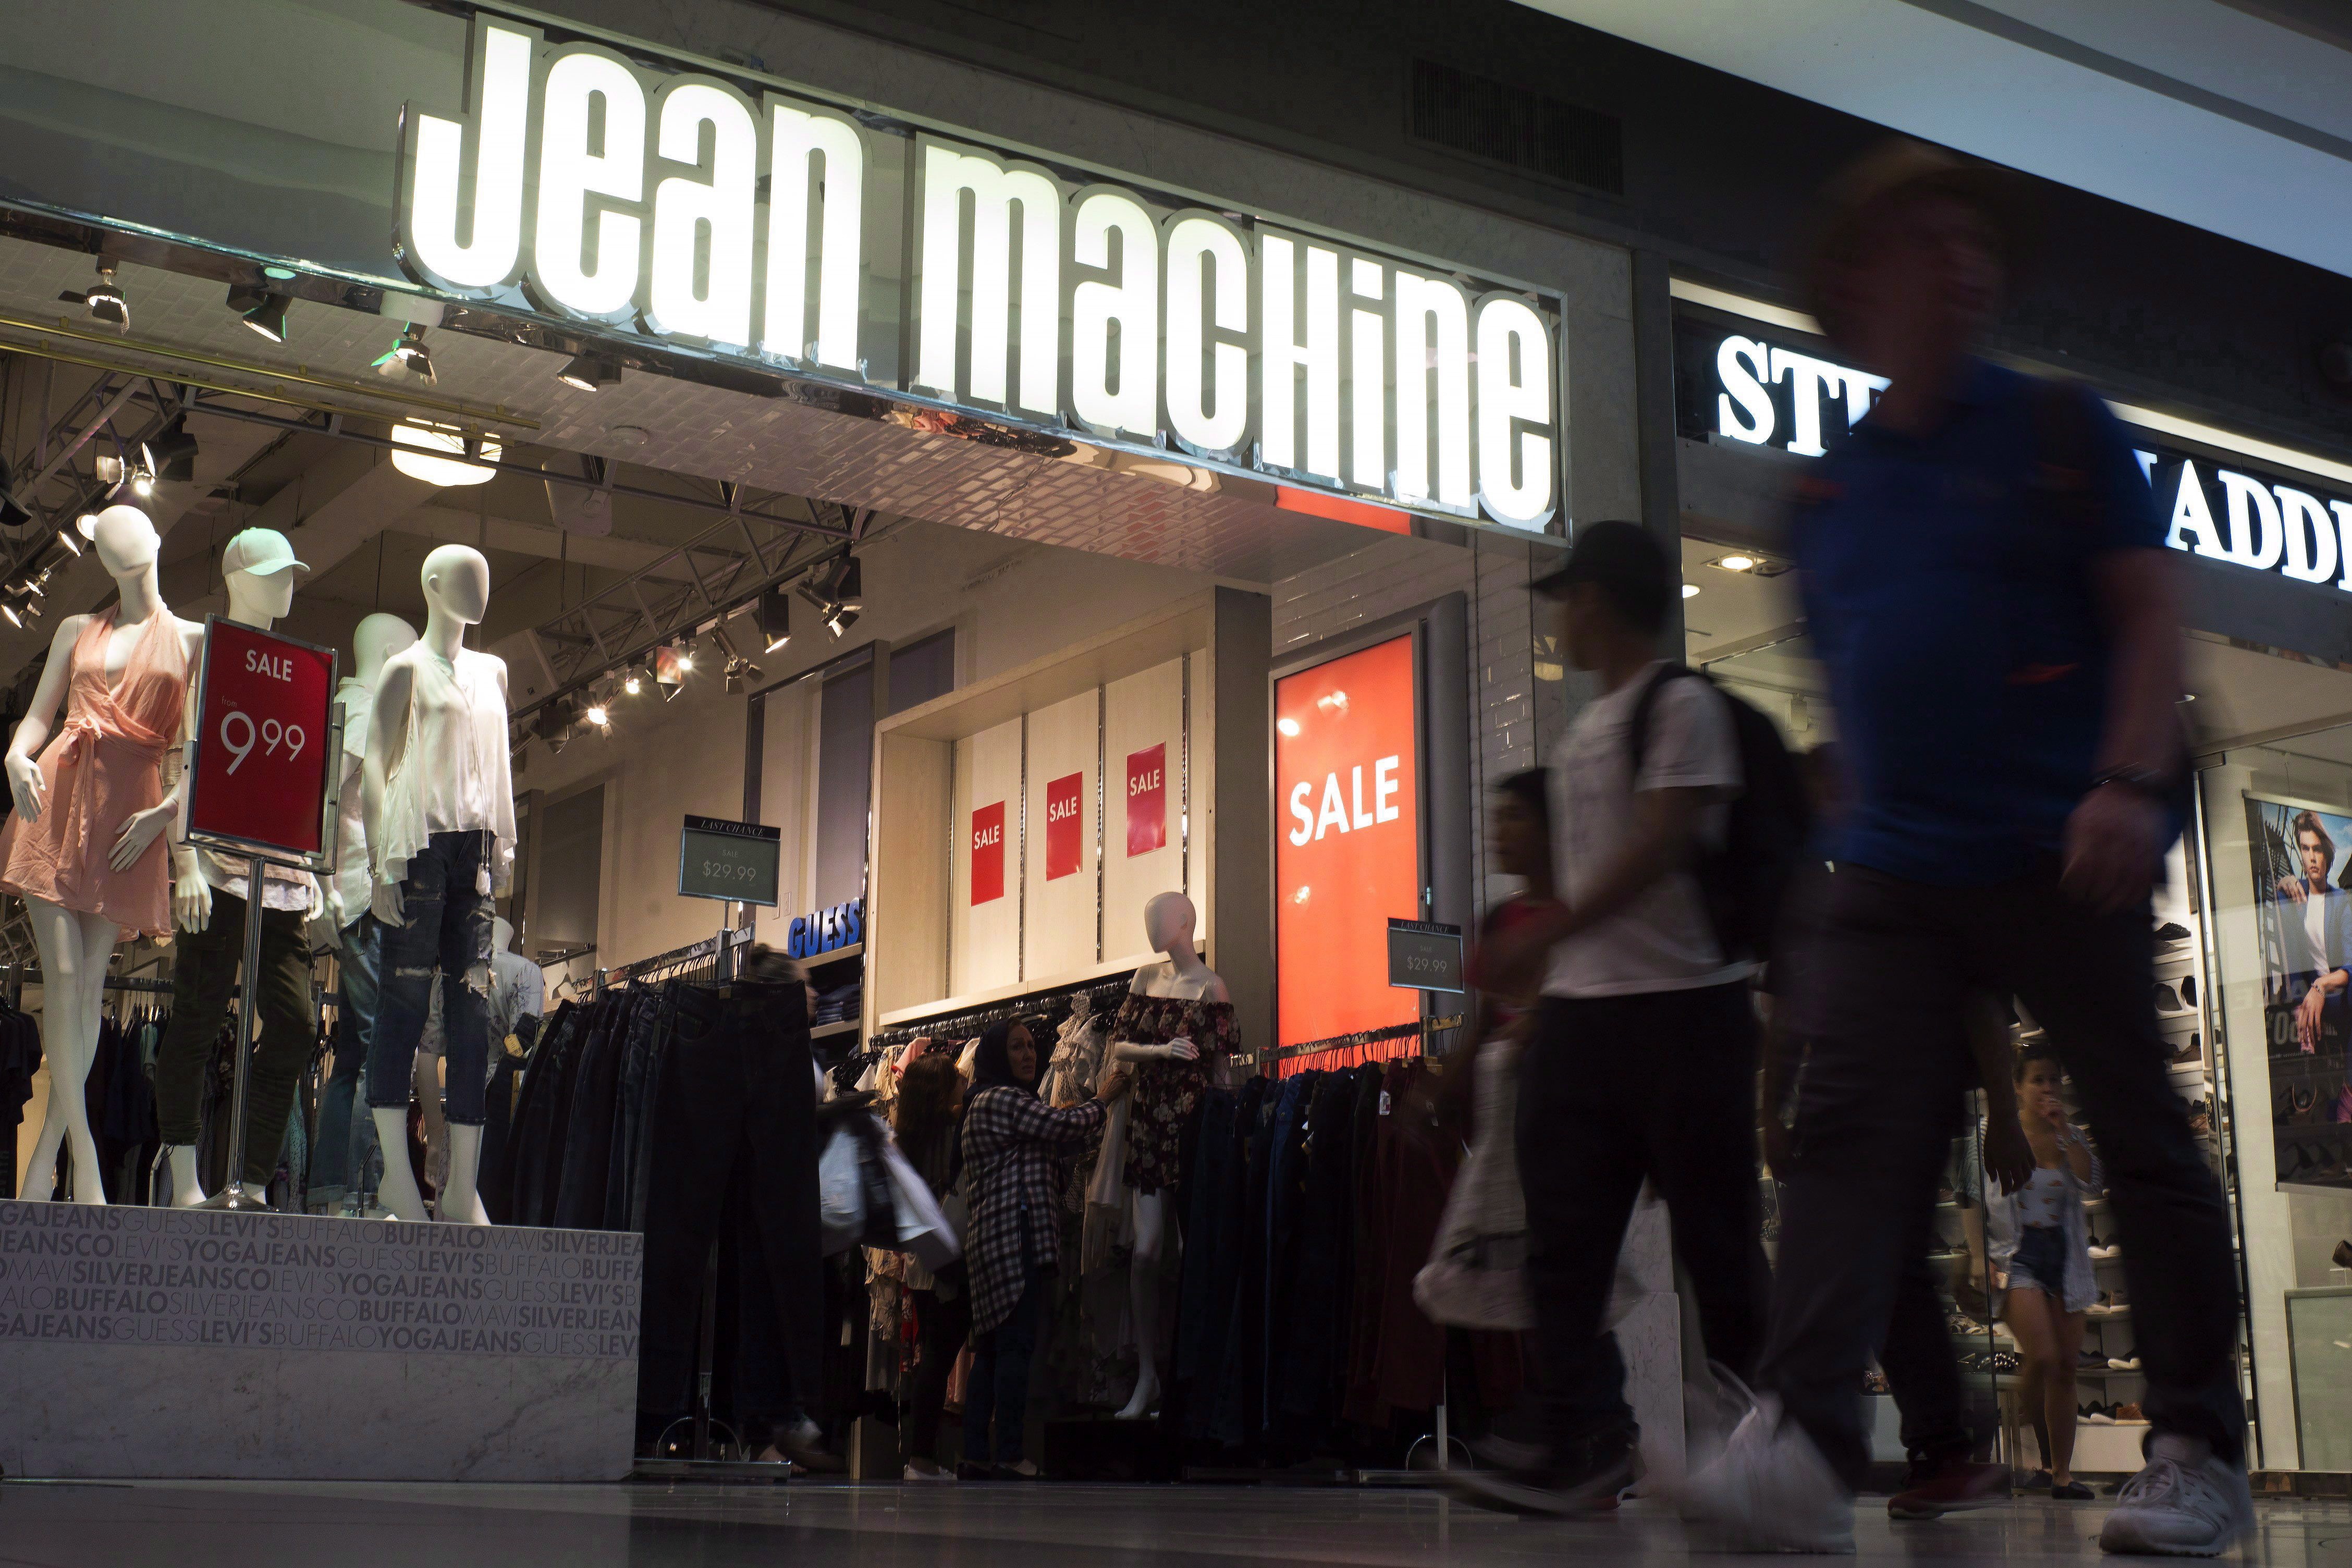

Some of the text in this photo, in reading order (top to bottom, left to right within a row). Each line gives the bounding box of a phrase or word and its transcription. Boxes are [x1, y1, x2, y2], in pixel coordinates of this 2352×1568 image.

[412, 26, 863, 371] Jean
[245, 649, 293, 682] SALE
[221, 696, 238, 708] from
[1130, 768, 1160, 797] SALE
[1049, 795, 1077, 822] SALE
[1289, 754, 1399, 847] SALE
[701, 820, 765, 837] LAST CHANCE
[974, 825, 1000, 850] SALE
[704, 860, 756, 882] $29.99
[788, 896, 860, 959] GUESS
[1401, 921, 1450, 934] LAST CHANCE
[1407, 955, 1448, 973] $29.99
[123, 1208, 207, 1235] GUESS
[281, 1218, 383, 1244] BUFFALO
[384, 1222, 486, 1249] BUFFALO
[337, 1246, 416, 1271] GUESS
[485, 1254, 581, 1278] BUFFALO
[484, 1279, 559, 1303] GUESS
[54, 1287, 168, 1314] BUFFALO
[359, 1300, 462, 1325] BUFFALO
[113, 1316, 199, 1342] GUESS
[273, 1322, 377, 1349] BUFFALO
[523, 1331, 598, 1355] GUESS
